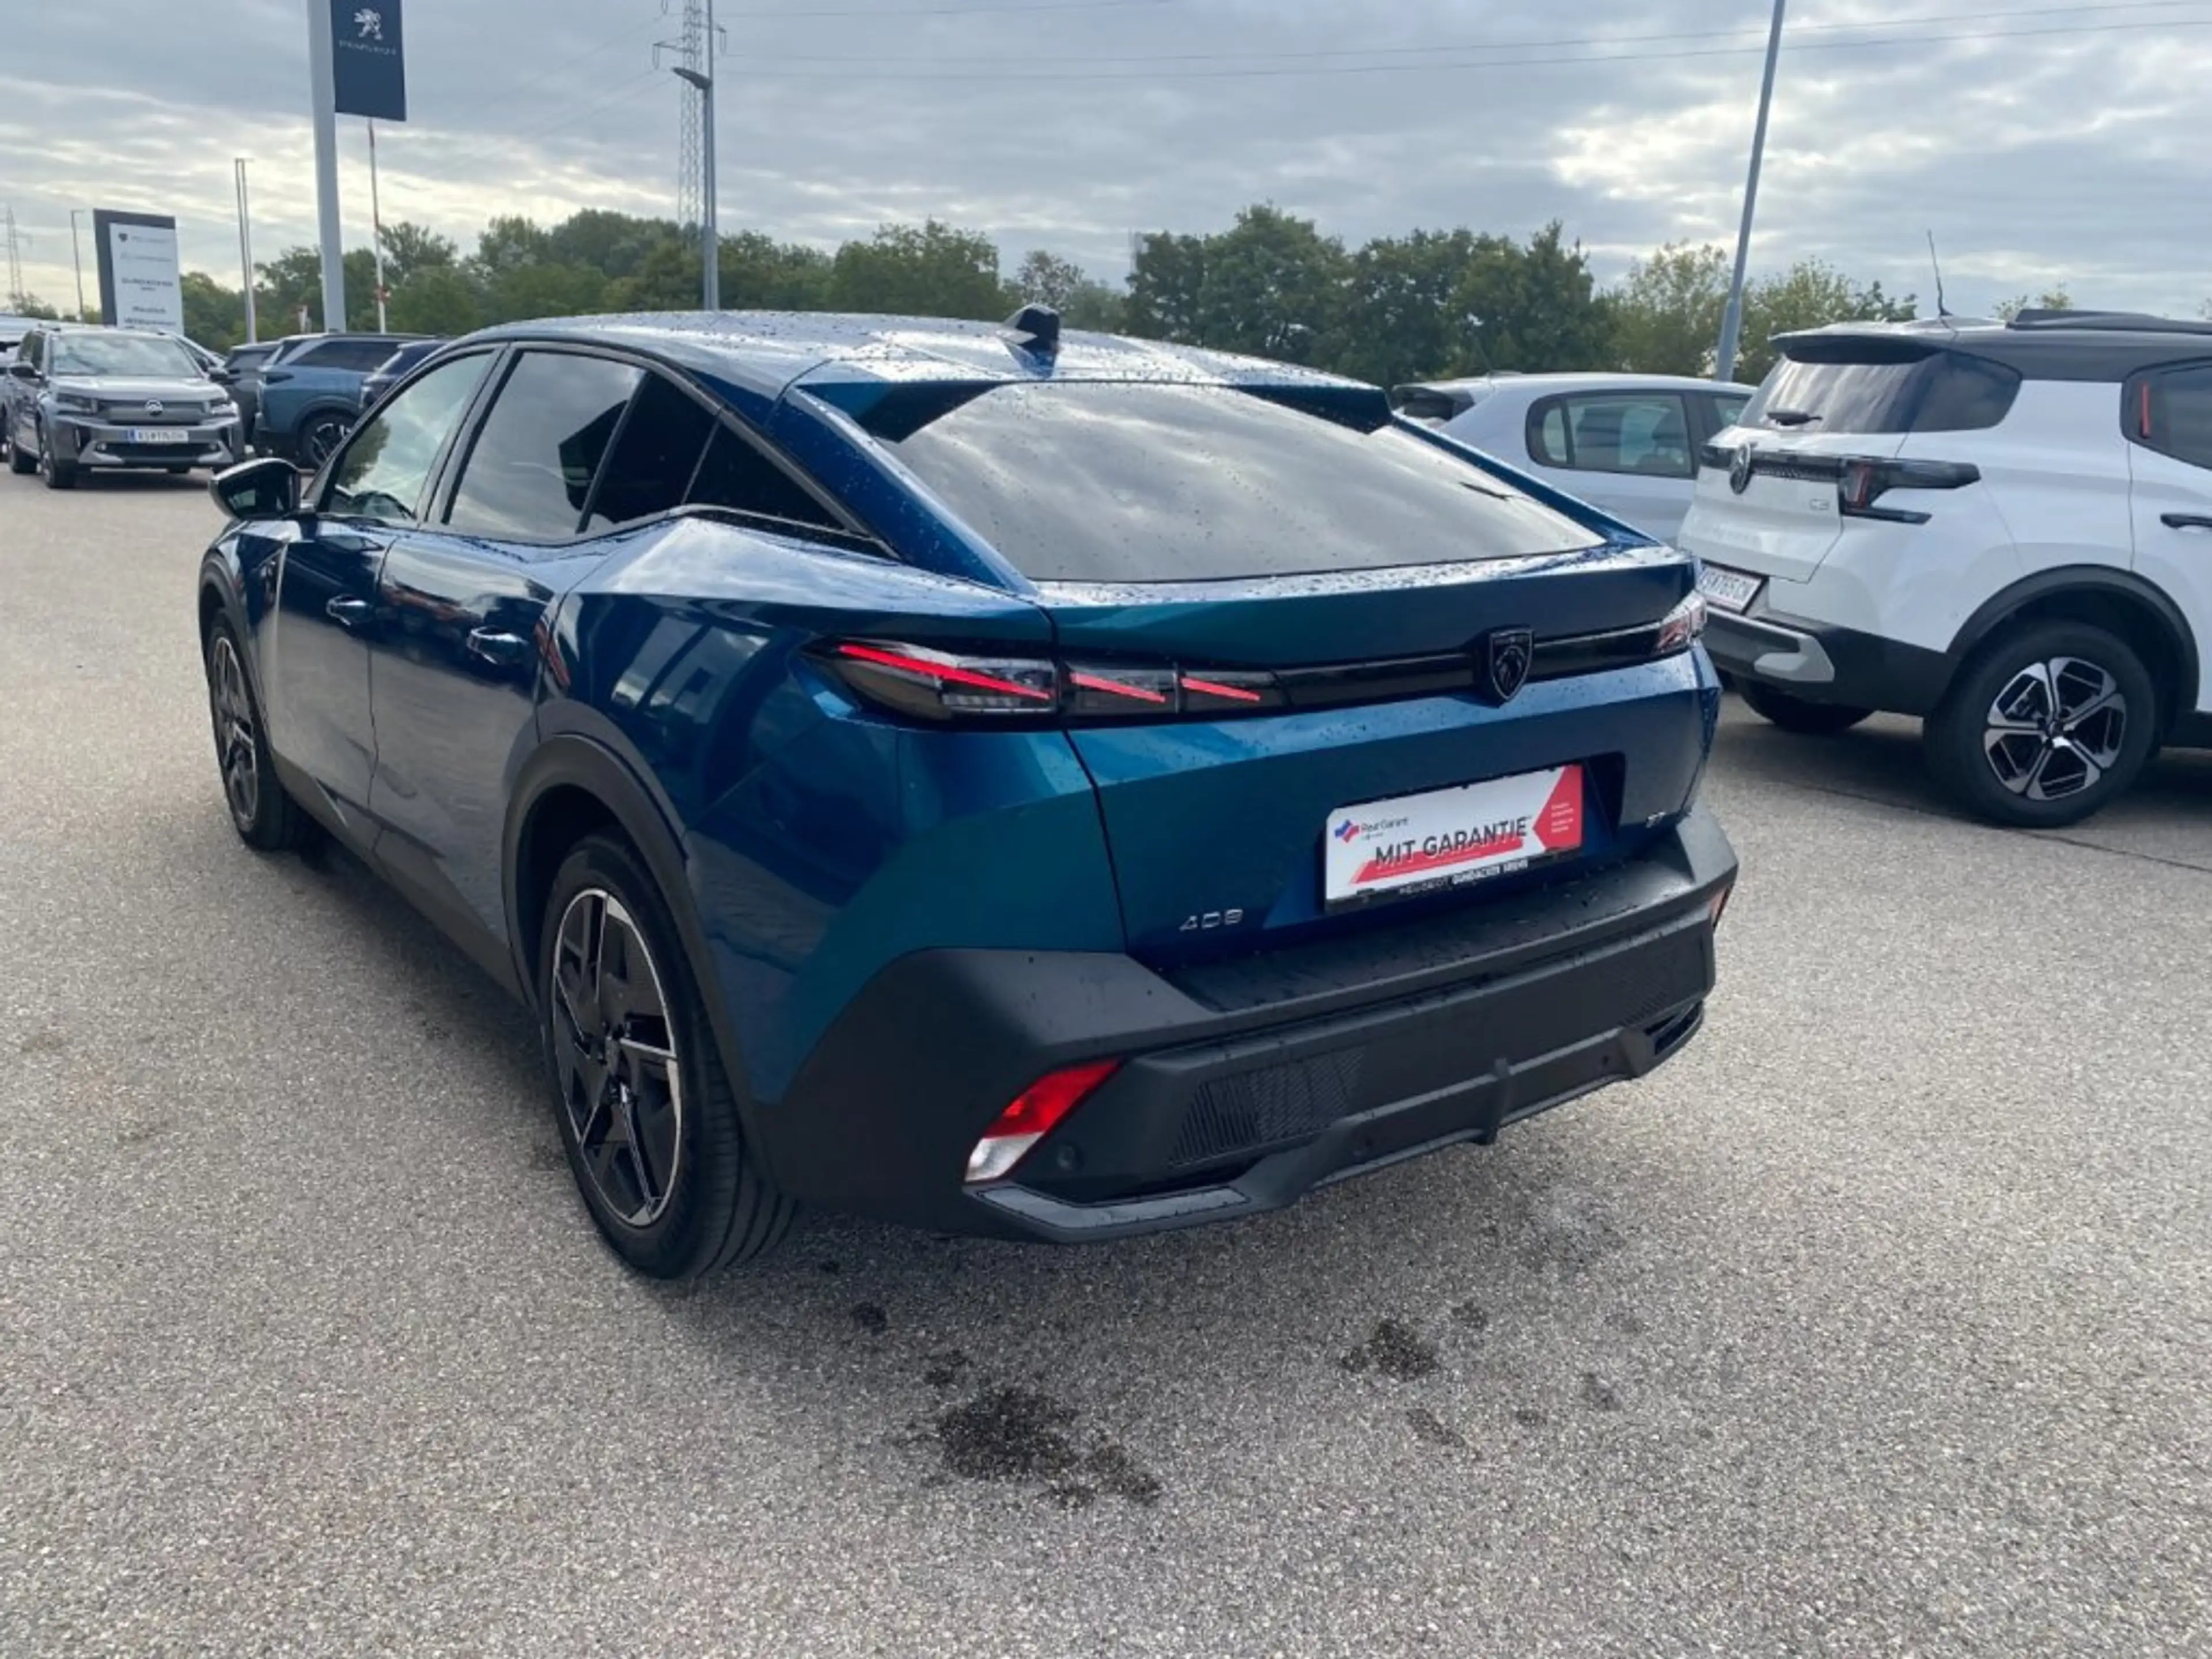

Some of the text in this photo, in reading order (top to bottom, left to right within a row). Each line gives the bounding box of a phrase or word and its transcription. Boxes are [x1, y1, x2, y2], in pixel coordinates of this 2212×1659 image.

[1376, 839, 1416, 865] MIT
[1423, 816, 1527, 857] GARANTIE
[1179, 908, 1243, 931] 408
